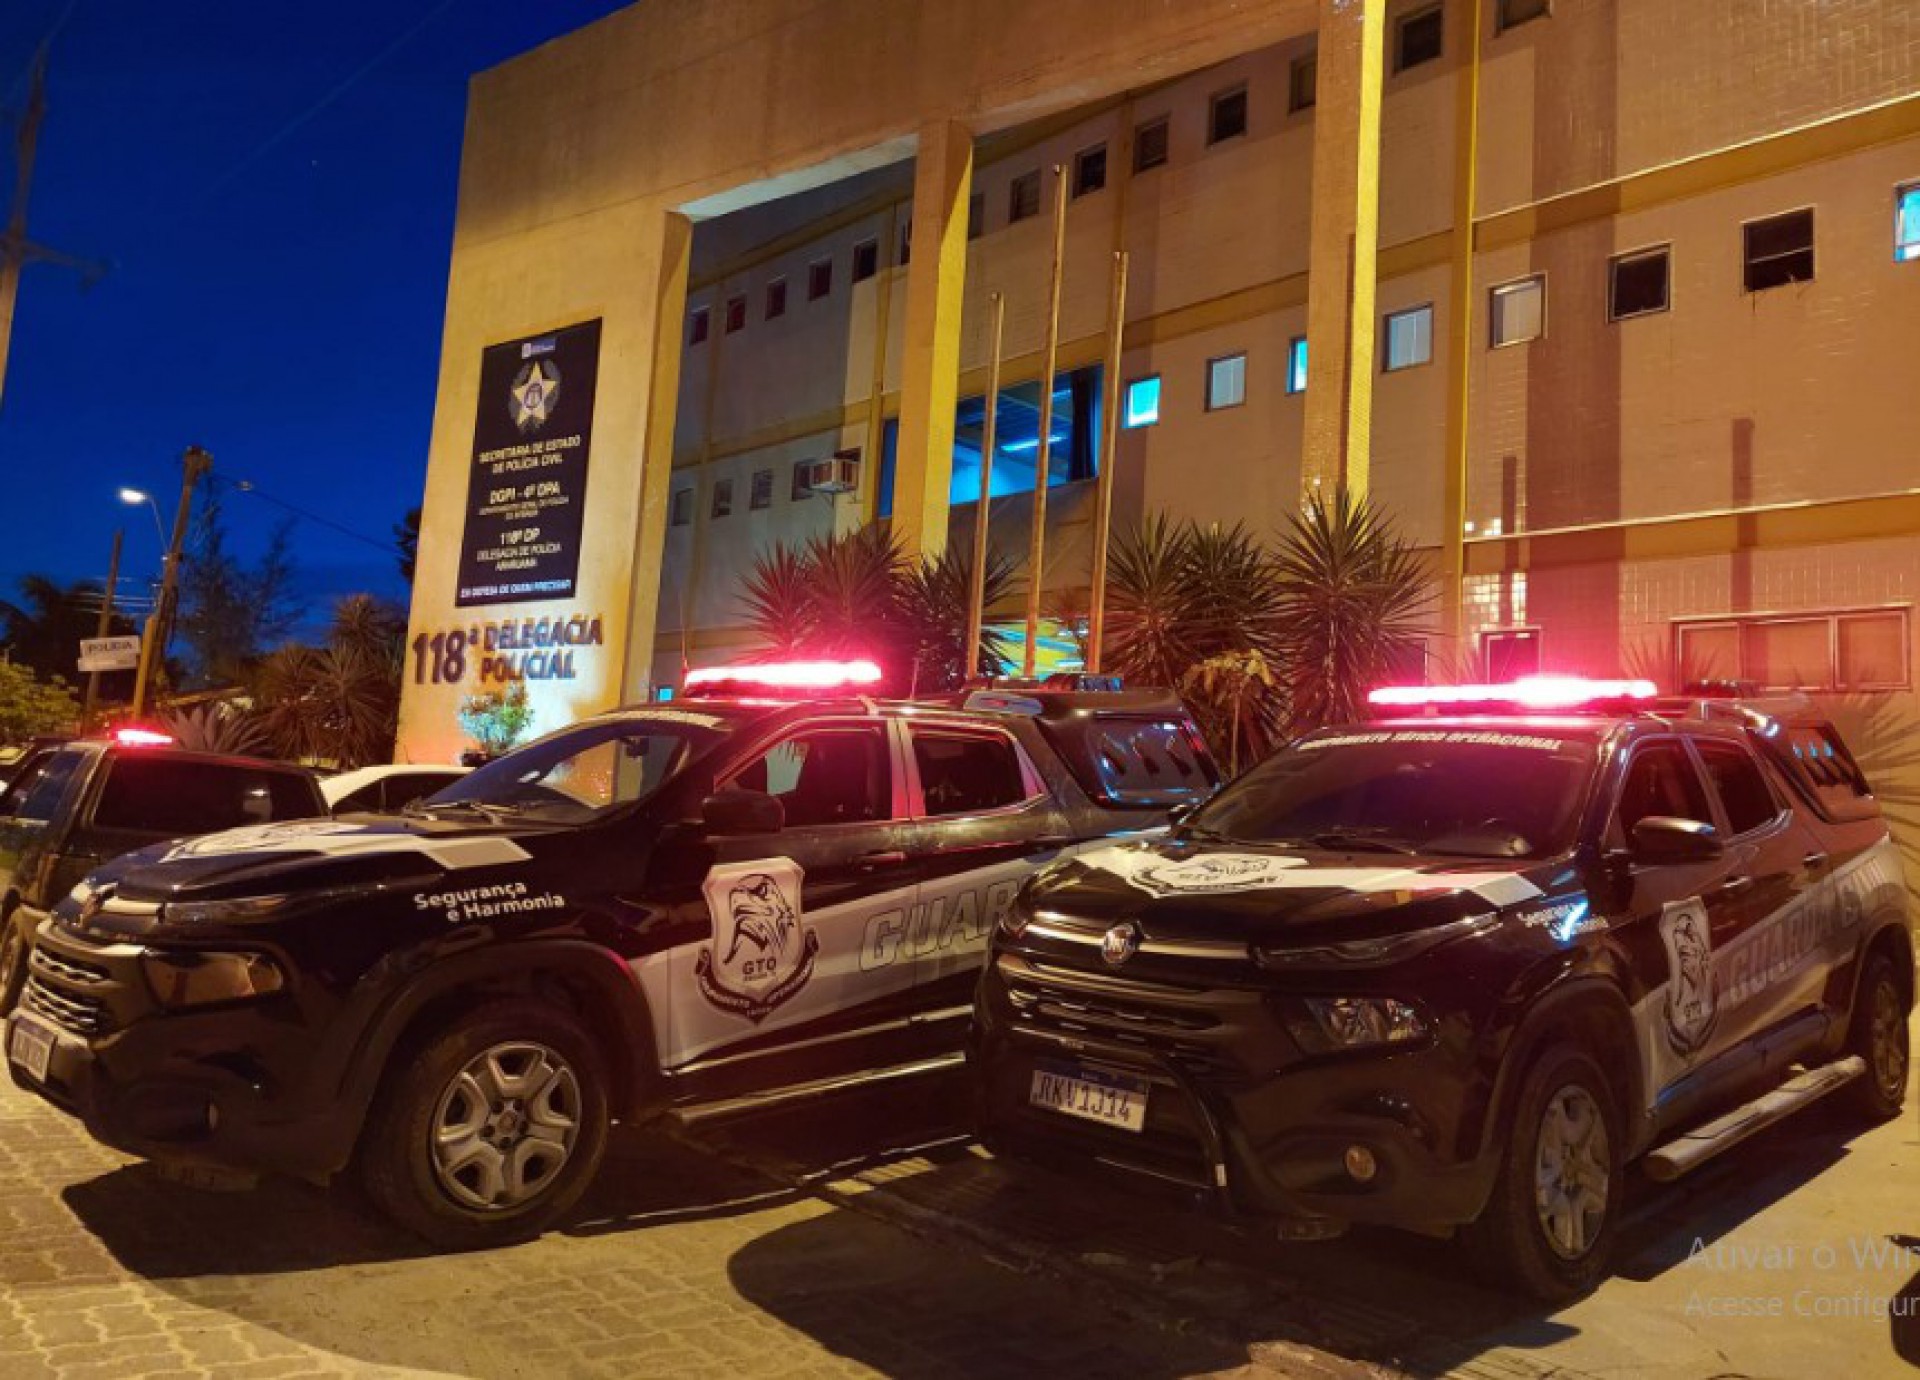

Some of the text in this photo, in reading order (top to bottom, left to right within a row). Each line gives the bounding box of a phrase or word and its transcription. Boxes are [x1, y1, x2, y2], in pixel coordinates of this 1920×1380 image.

[483, 614, 603, 651] DELEGACIA
[480, 650, 577, 684] POLICIAL
[414, 882, 527, 910] Segurança
[446, 892, 565, 922] e Harmonia
[859, 875, 1036, 972] GUAR
[742, 957, 777, 975] GTO
